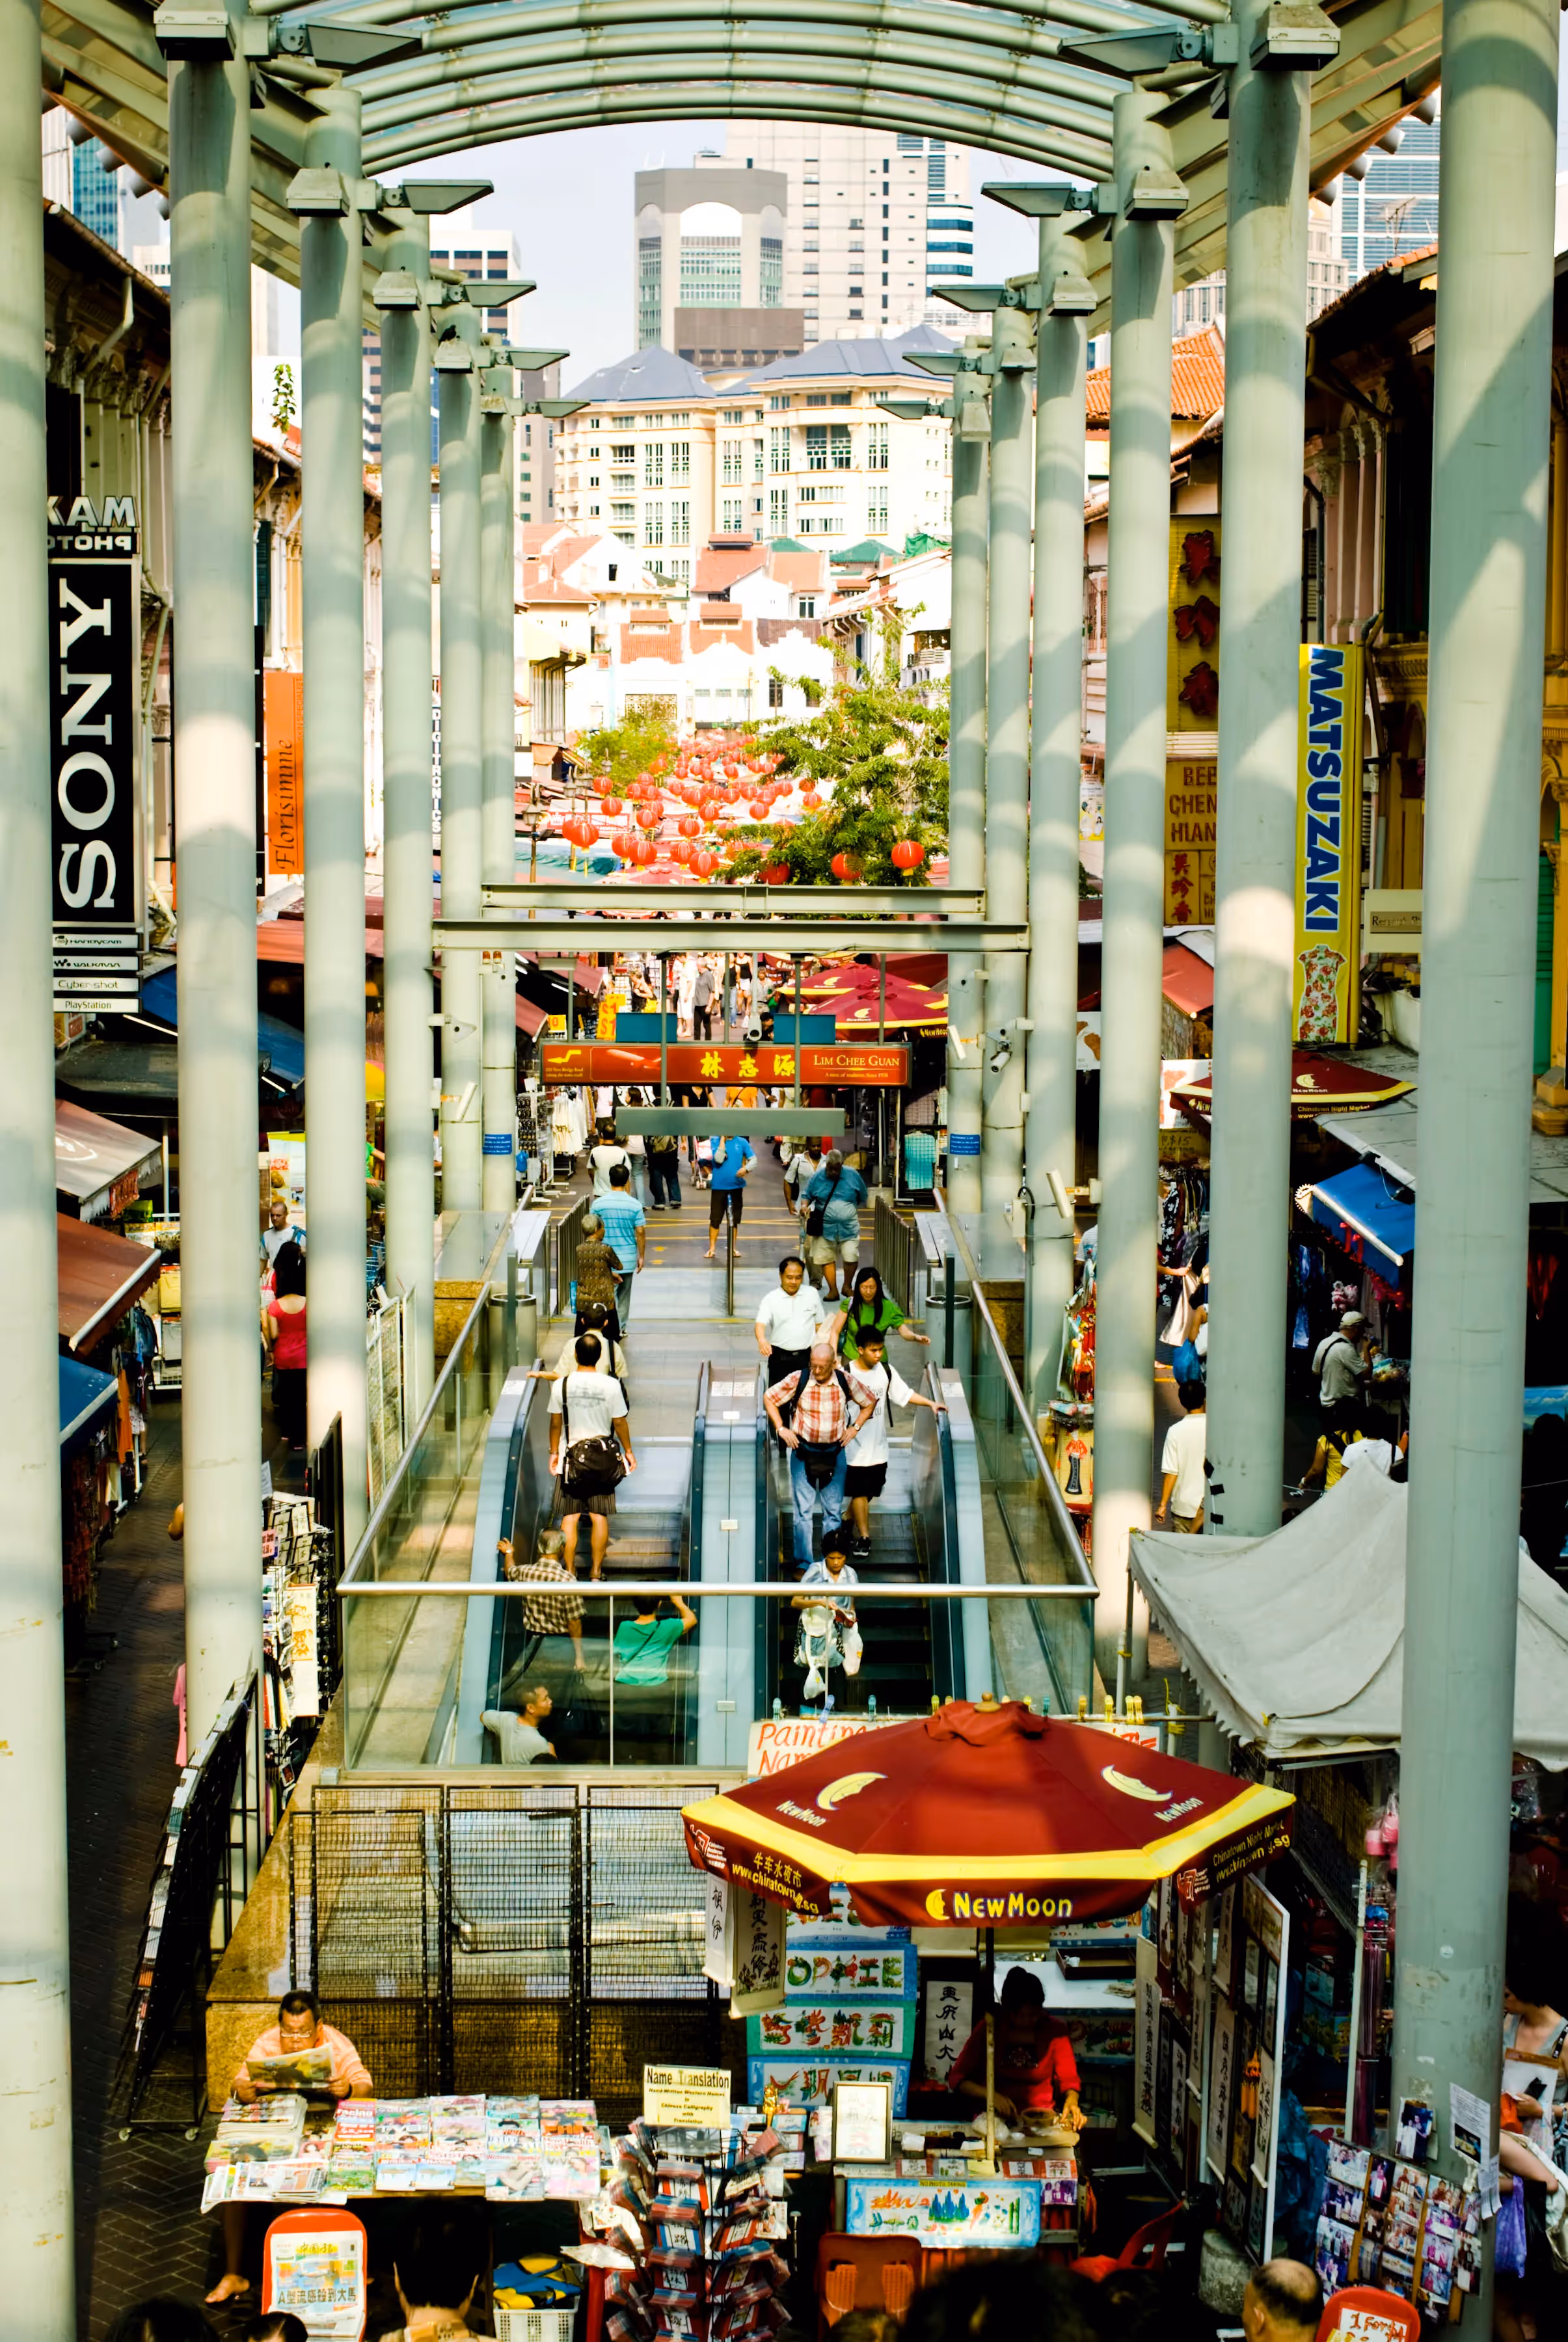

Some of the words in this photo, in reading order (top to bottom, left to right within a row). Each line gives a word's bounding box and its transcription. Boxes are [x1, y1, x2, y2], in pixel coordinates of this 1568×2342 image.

[58, 578, 116, 908] SONY
[432, 708, 441, 833] DIGITRONICS
[270, 739, 294, 870] Florisimme
[1304, 647, 1344, 932] MATSUZAKI
[65, 1001, 111, 1009] PlayStation
[701, 1051, 795, 1078] 林志源
[753, 1852, 802, 1888] 牛车水夜市
[1213, 1841, 1247, 1866] Chinatown
[647, 2067, 672, 2084] Name
[678, 2070, 729, 2088] Translation
